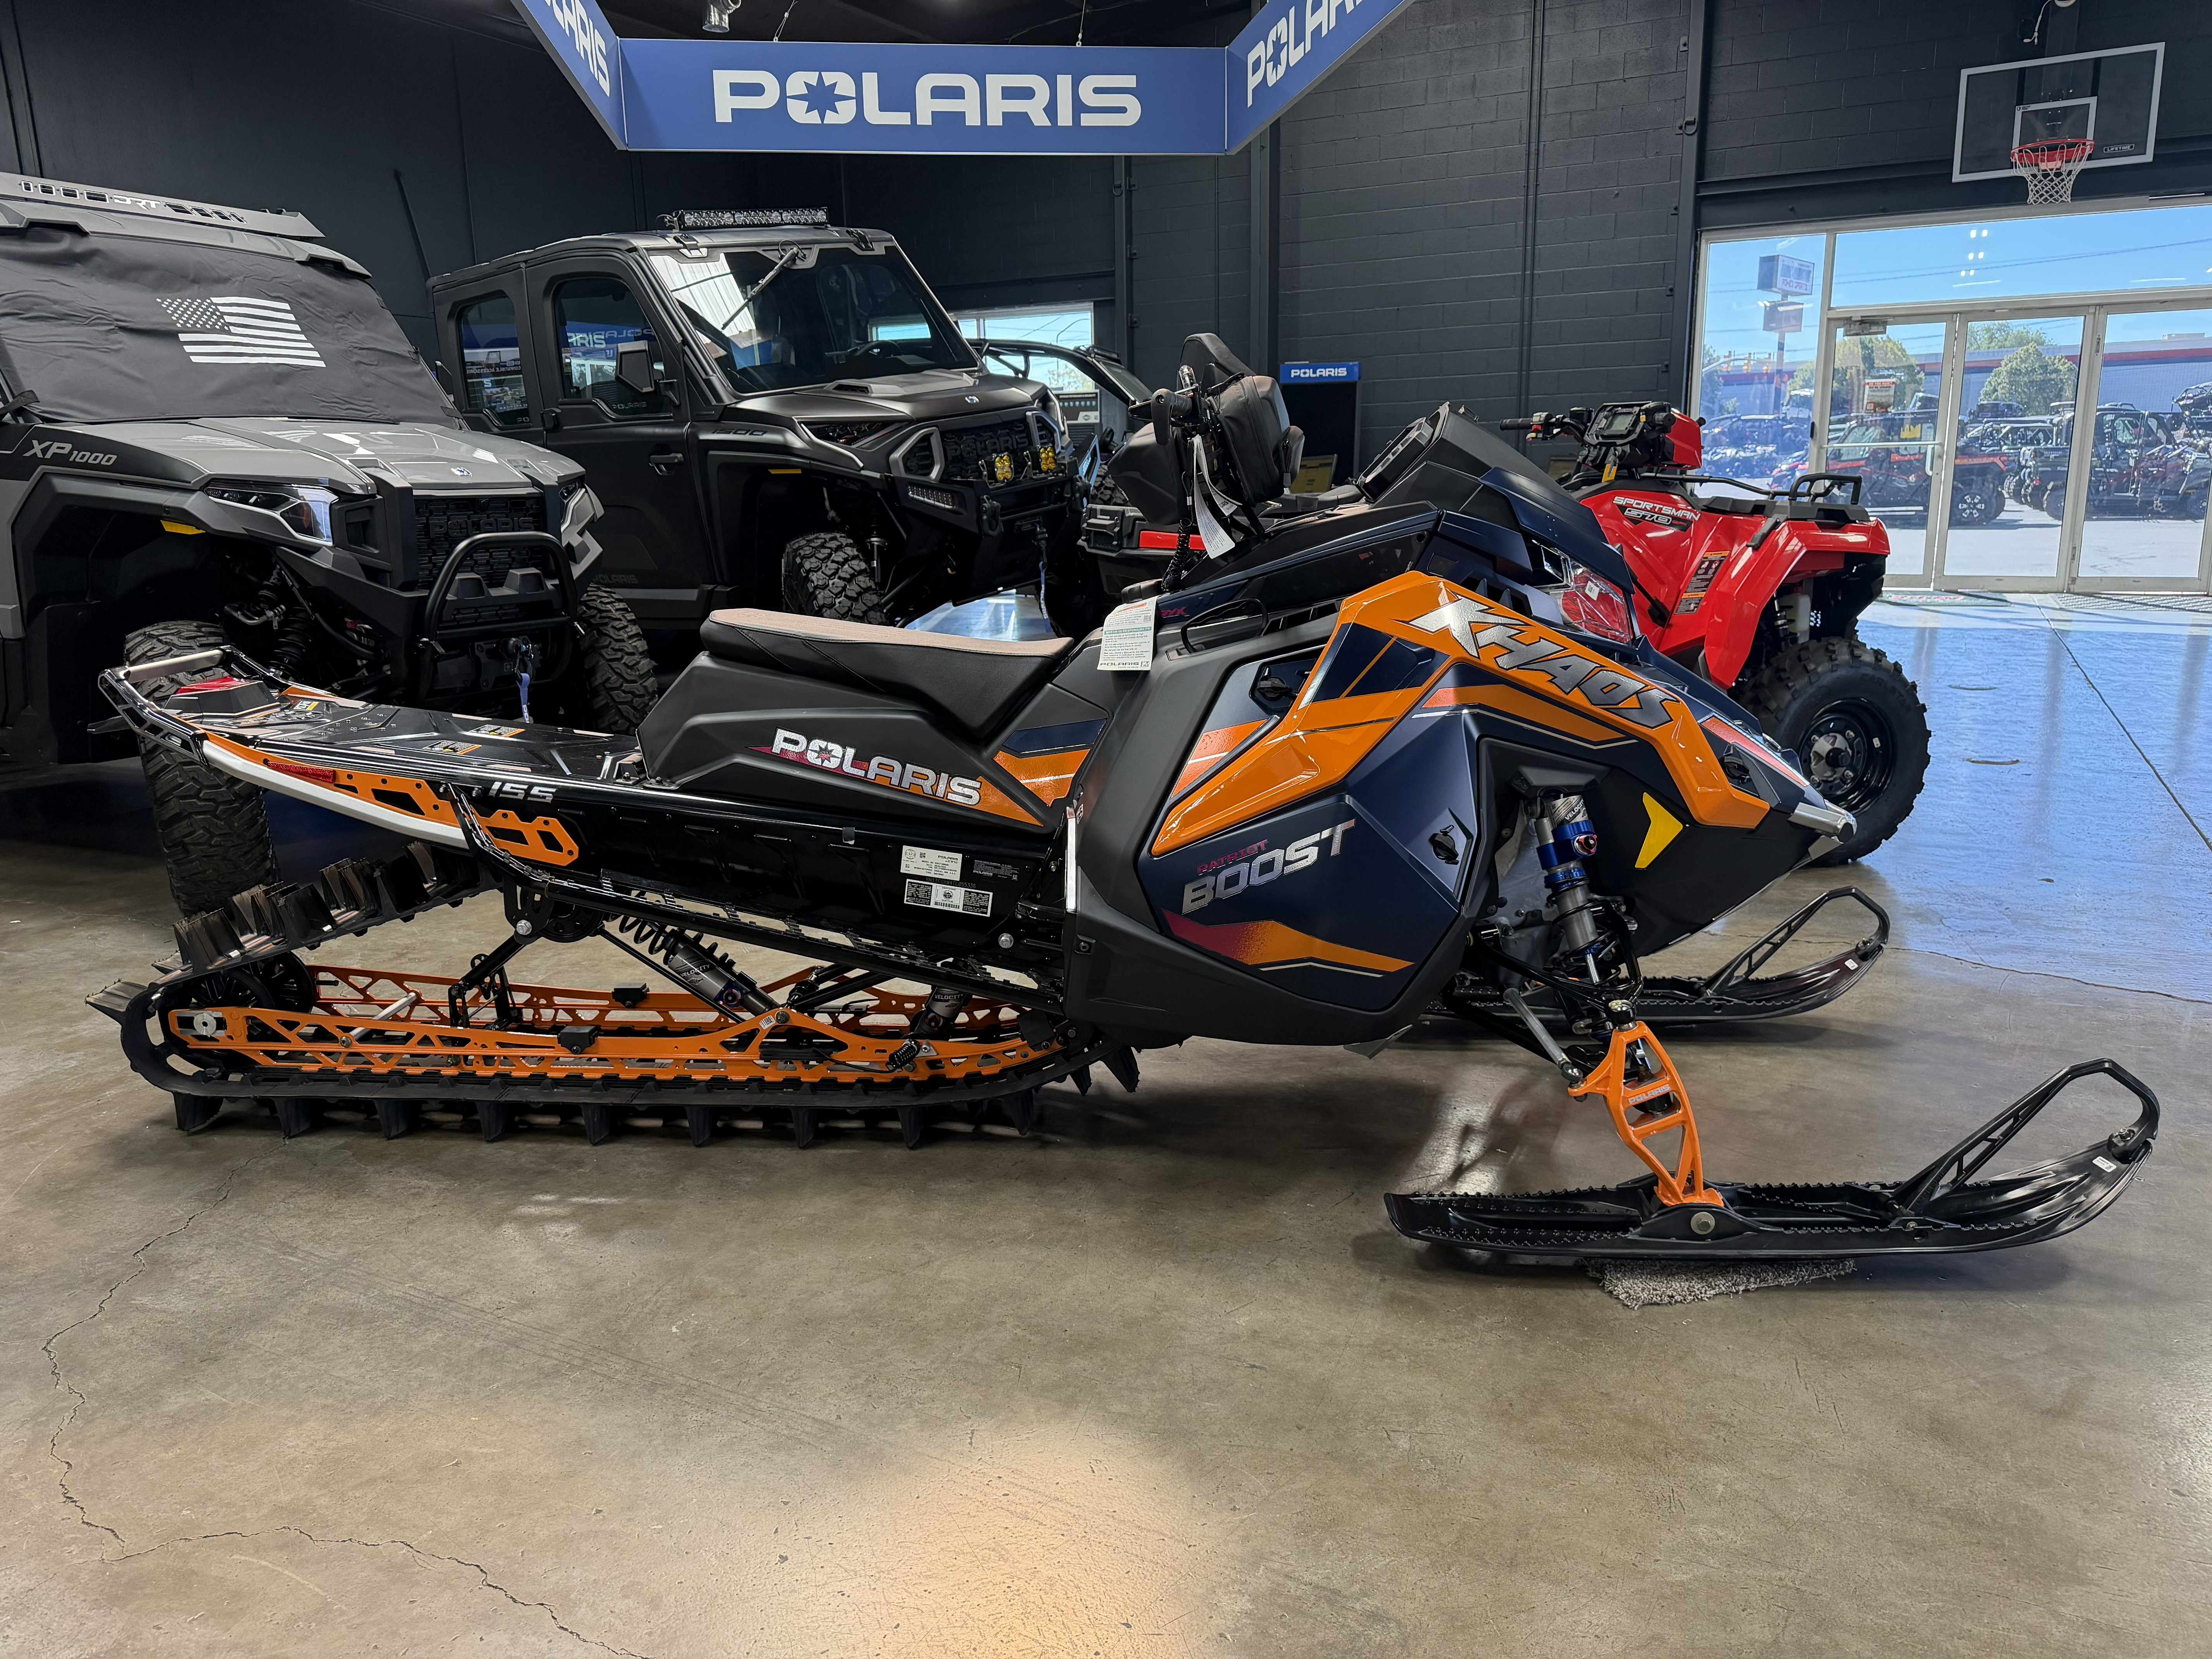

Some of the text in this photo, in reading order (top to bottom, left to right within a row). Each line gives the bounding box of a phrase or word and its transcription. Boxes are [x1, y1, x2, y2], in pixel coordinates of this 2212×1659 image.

[713, 70, 1142, 126] POLARIS
[113, 194, 160, 210] DRT
[1291, 368, 1347, 378] POLARIS
[711, 428, 768, 436] 1500
[22, 440, 117, 465] XP 1000
[945, 433, 1029, 460] POLARIS
[1613, 496, 1701, 521] SPORTSMAN
[1624, 508, 1672, 525] 570
[429, 517, 534, 539] POLARIS
[771, 727, 982, 806] POLARIS
[488, 781, 558, 804] 155
[1182, 818, 1356, 915] BOOST
[1197, 839, 1268, 876] PATRIOT
[1628, 1084, 1671, 1104] POLARIS
